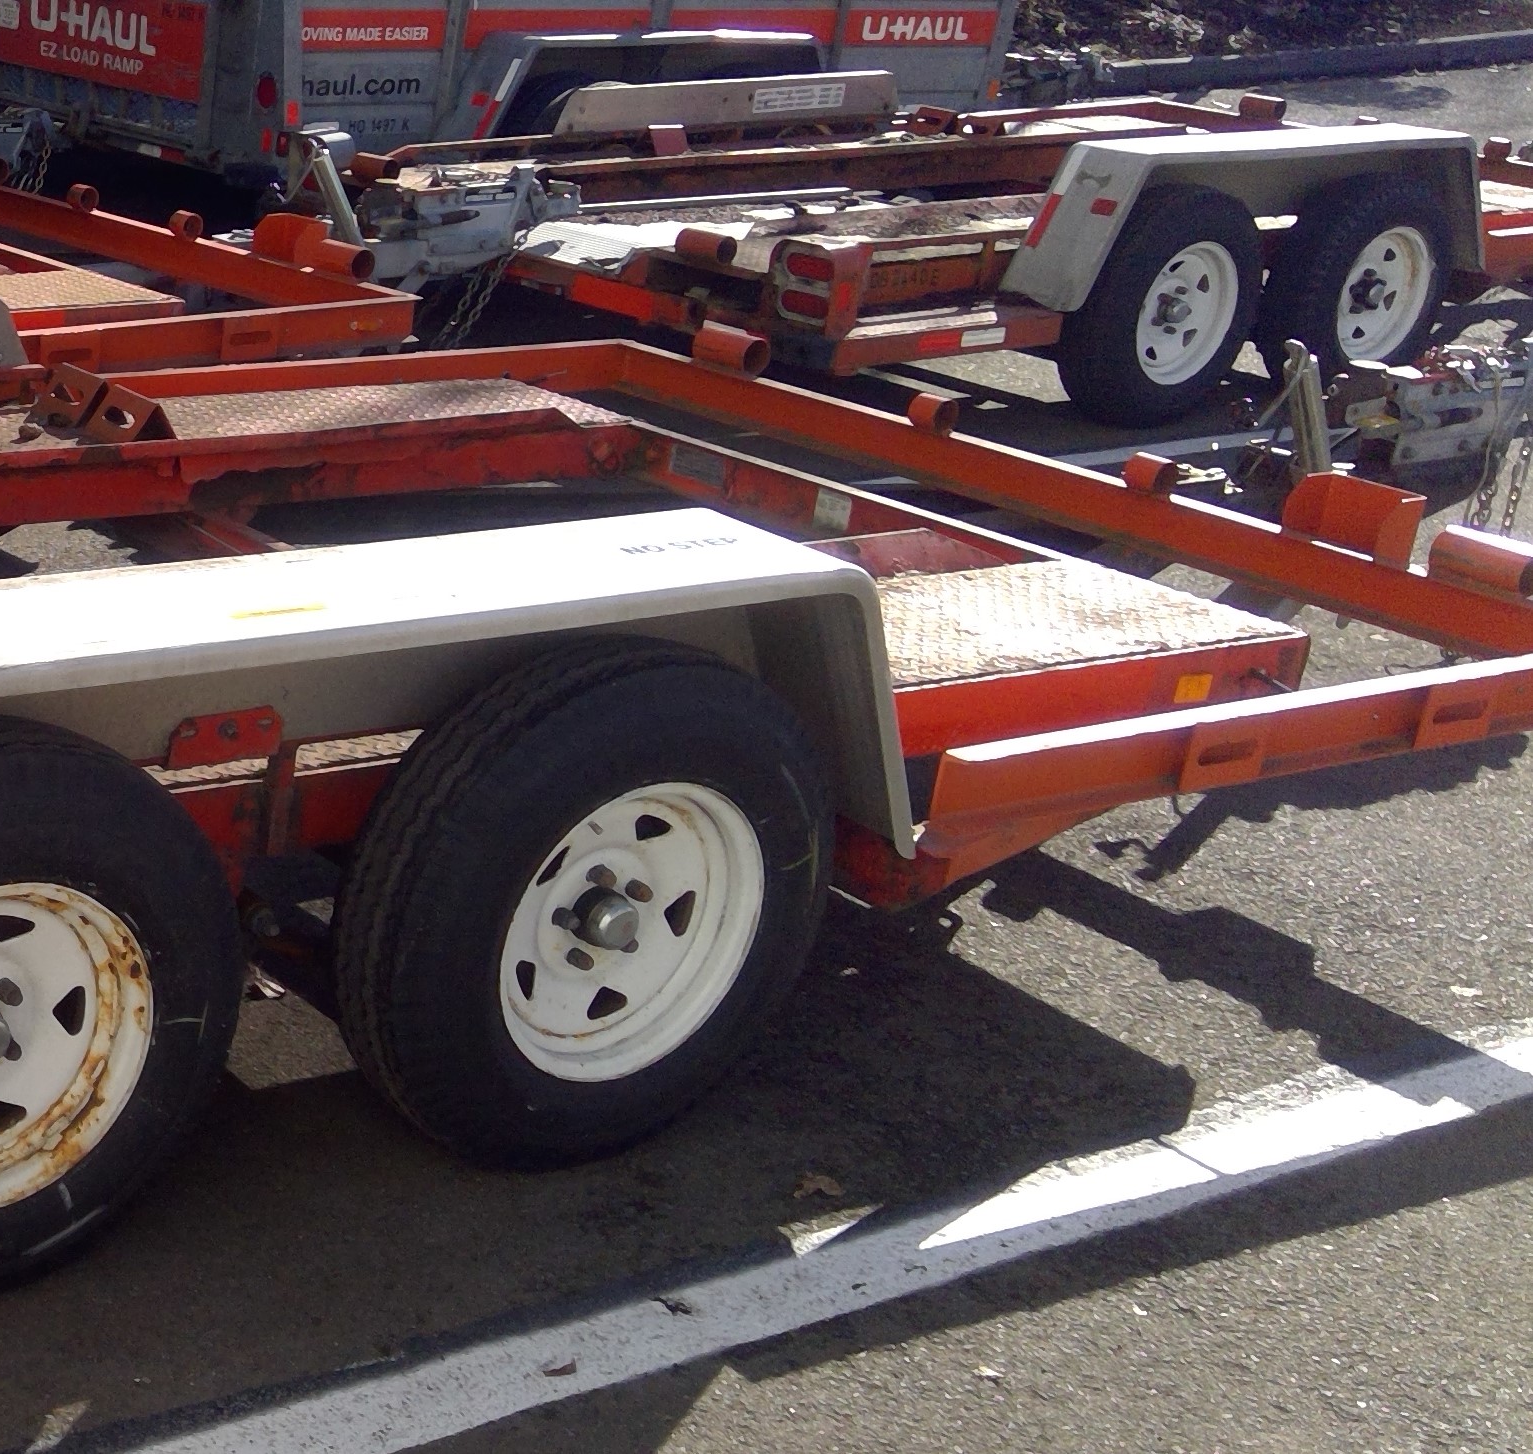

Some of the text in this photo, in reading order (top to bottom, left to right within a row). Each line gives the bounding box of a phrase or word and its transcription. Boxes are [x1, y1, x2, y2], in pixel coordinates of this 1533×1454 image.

[30, 0, 156, 57] U-HAUL
[345, 27, 383, 41] MADE
[385, 26, 429, 41] EASIER
[861, 16, 968, 41] U-HAUL
[39, 40, 144, 76] EZ LOAD RAMP
[302, 73, 421, 97] haul.com
[619, 544, 665, 555] NO
